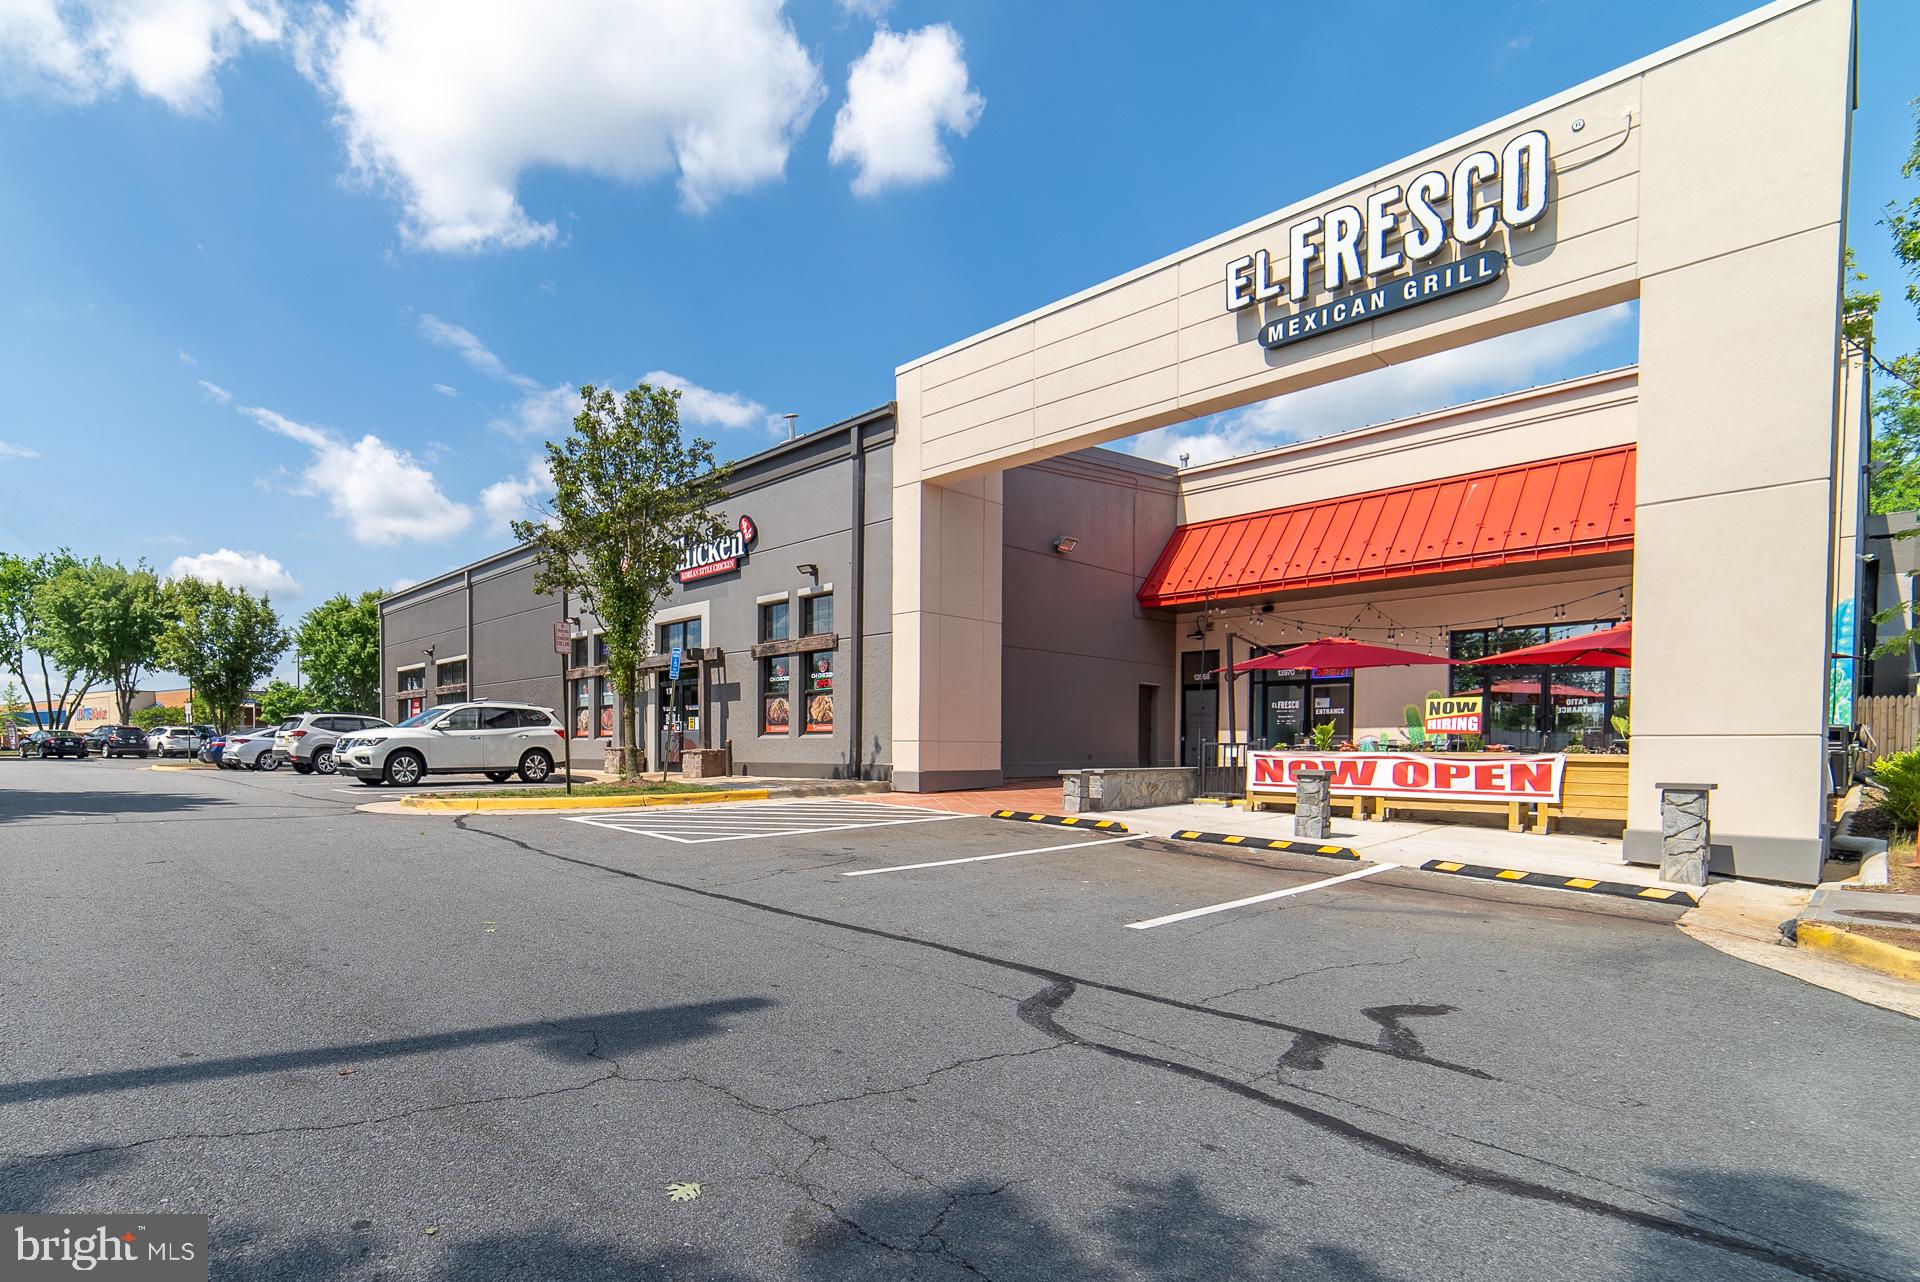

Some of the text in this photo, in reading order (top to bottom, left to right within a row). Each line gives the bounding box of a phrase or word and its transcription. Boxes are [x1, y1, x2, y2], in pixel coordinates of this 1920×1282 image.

[1226, 129, 1549, 313] EL FRESCO
[1267, 256, 1493, 344] MEXICAN GRILL
[1277, 669, 1295, 677] 13970
[1277, 701, 1300, 710] FRESCO
[1315, 707, 1345, 715] ENTRANCE
[1429, 701, 1477, 715] NOW
[1427, 717, 1478, 732] HIRING
[1254, 758, 1552, 792] NOW OPEN
